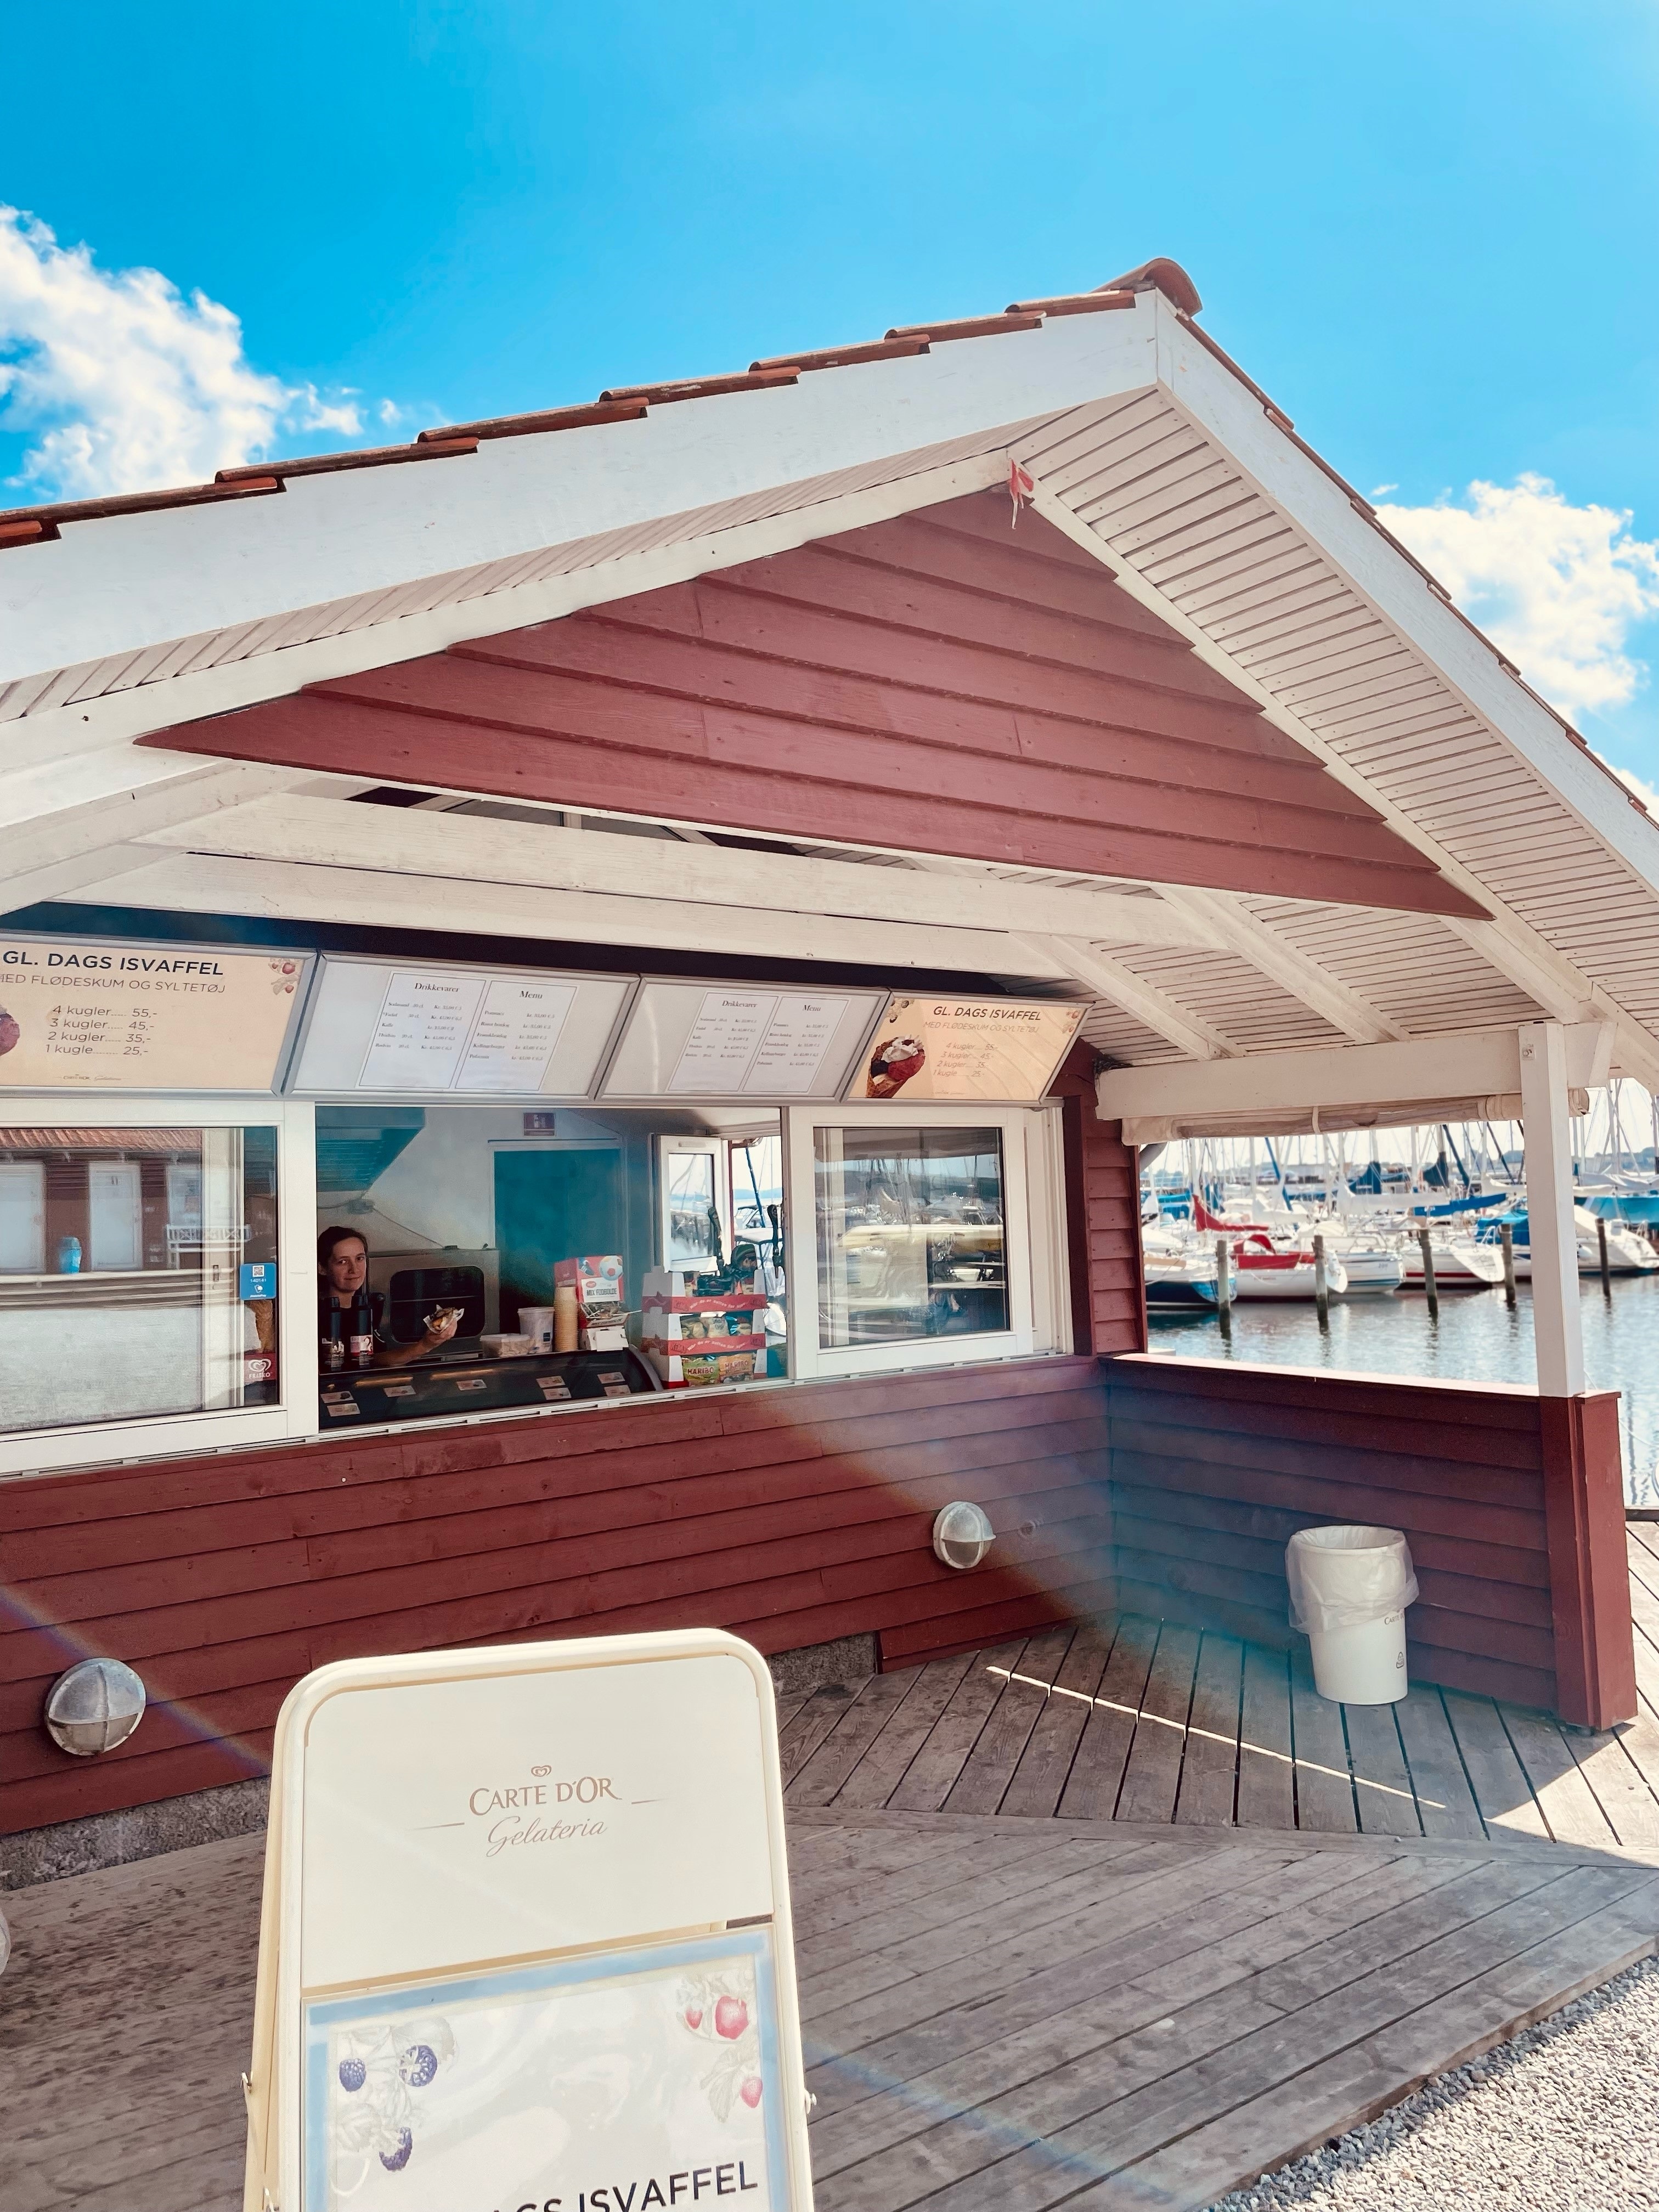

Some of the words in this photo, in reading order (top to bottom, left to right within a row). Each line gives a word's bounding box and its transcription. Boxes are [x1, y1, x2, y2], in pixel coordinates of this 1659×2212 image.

[3, 951, 38, 966] GL.
[48, 953, 112, 969] DAGS
[120, 957, 223, 975] ISVAFFEL
[31, 975, 124, 988] FLØDESKUM
[129, 980, 151, 990] OG
[155, 981, 225, 993] SYLTETØJ
[414, 982, 460, 992] Drikkevarer
[519, 990, 543, 999] Menu
[52, 1005, 62, 1014] 4
[132, 1008, 157, 1018] 55,-
[933, 1006, 951, 1015] GL.
[954, 1007, 988, 1018] DAGS
[989, 1009, 1042, 1020] ISVAFFEL
[49, 1018, 58, 1027] 3
[128, 1021, 155, 1031] 45,-
[943, 1022, 989, 1030] FLØDESKUM
[1002, 1025, 1040, 1033] SYLTETØJ
[47, 1031, 57, 1040] 2
[126, 1034, 151, 1043] 35,-
[46, 1044, 50, 1053] 1
[123, 1046, 149, 1056] 25,-
[725, 1360, 749, 1369] HARIBO
[687, 1367, 714, 1375] HARIBO
[1384, 1615, 1400, 1625] CARTE
[469, 1785, 547, 1816] CARTE
[555, 1776, 623, 1803] D'OR
[486, 1815, 608, 1857] Gelateria
[579, 2160, 758, 2212] ISVAFFEL
